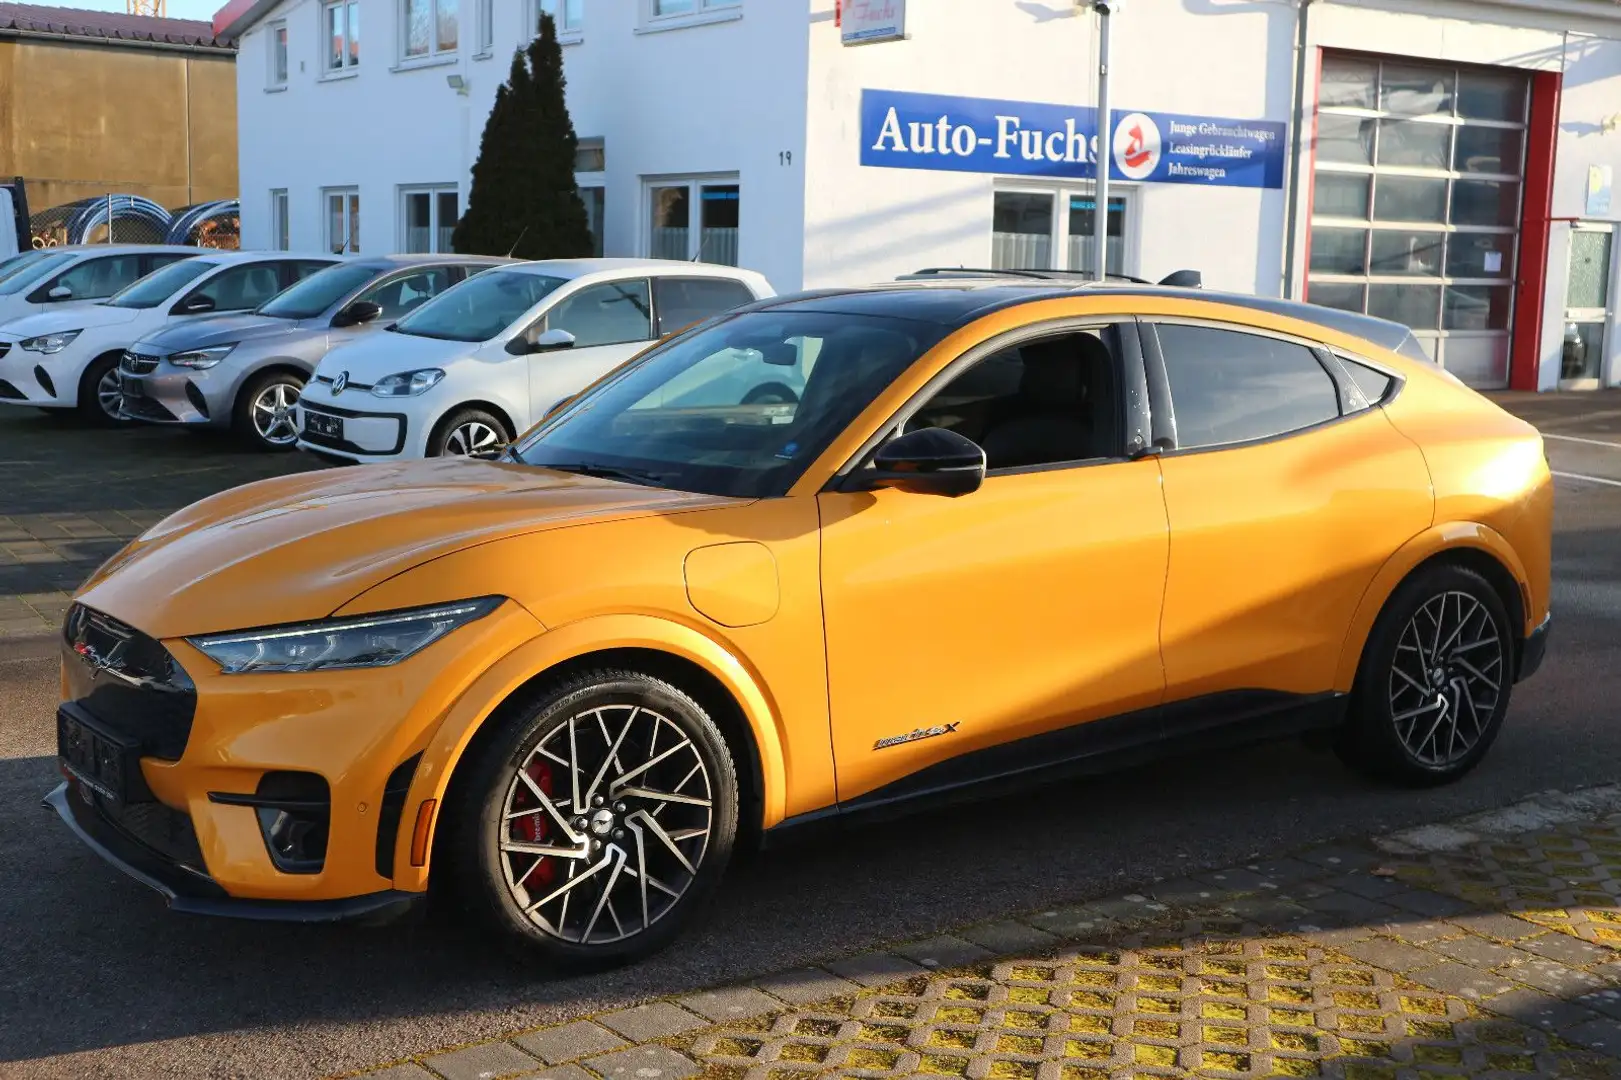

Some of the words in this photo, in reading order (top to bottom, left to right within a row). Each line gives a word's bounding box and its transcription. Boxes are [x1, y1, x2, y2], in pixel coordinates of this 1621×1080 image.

[1169, 120, 1197, 136] Junge
[1199, 122, 1275, 142] Gebrauchtwagen
[778, 150, 792, 166] 19
[1169, 141, 1252, 159] Leasingrückläufer
[1168, 162, 1226, 180] Jahreswagen
[532, 812, 541, 842] bremb
